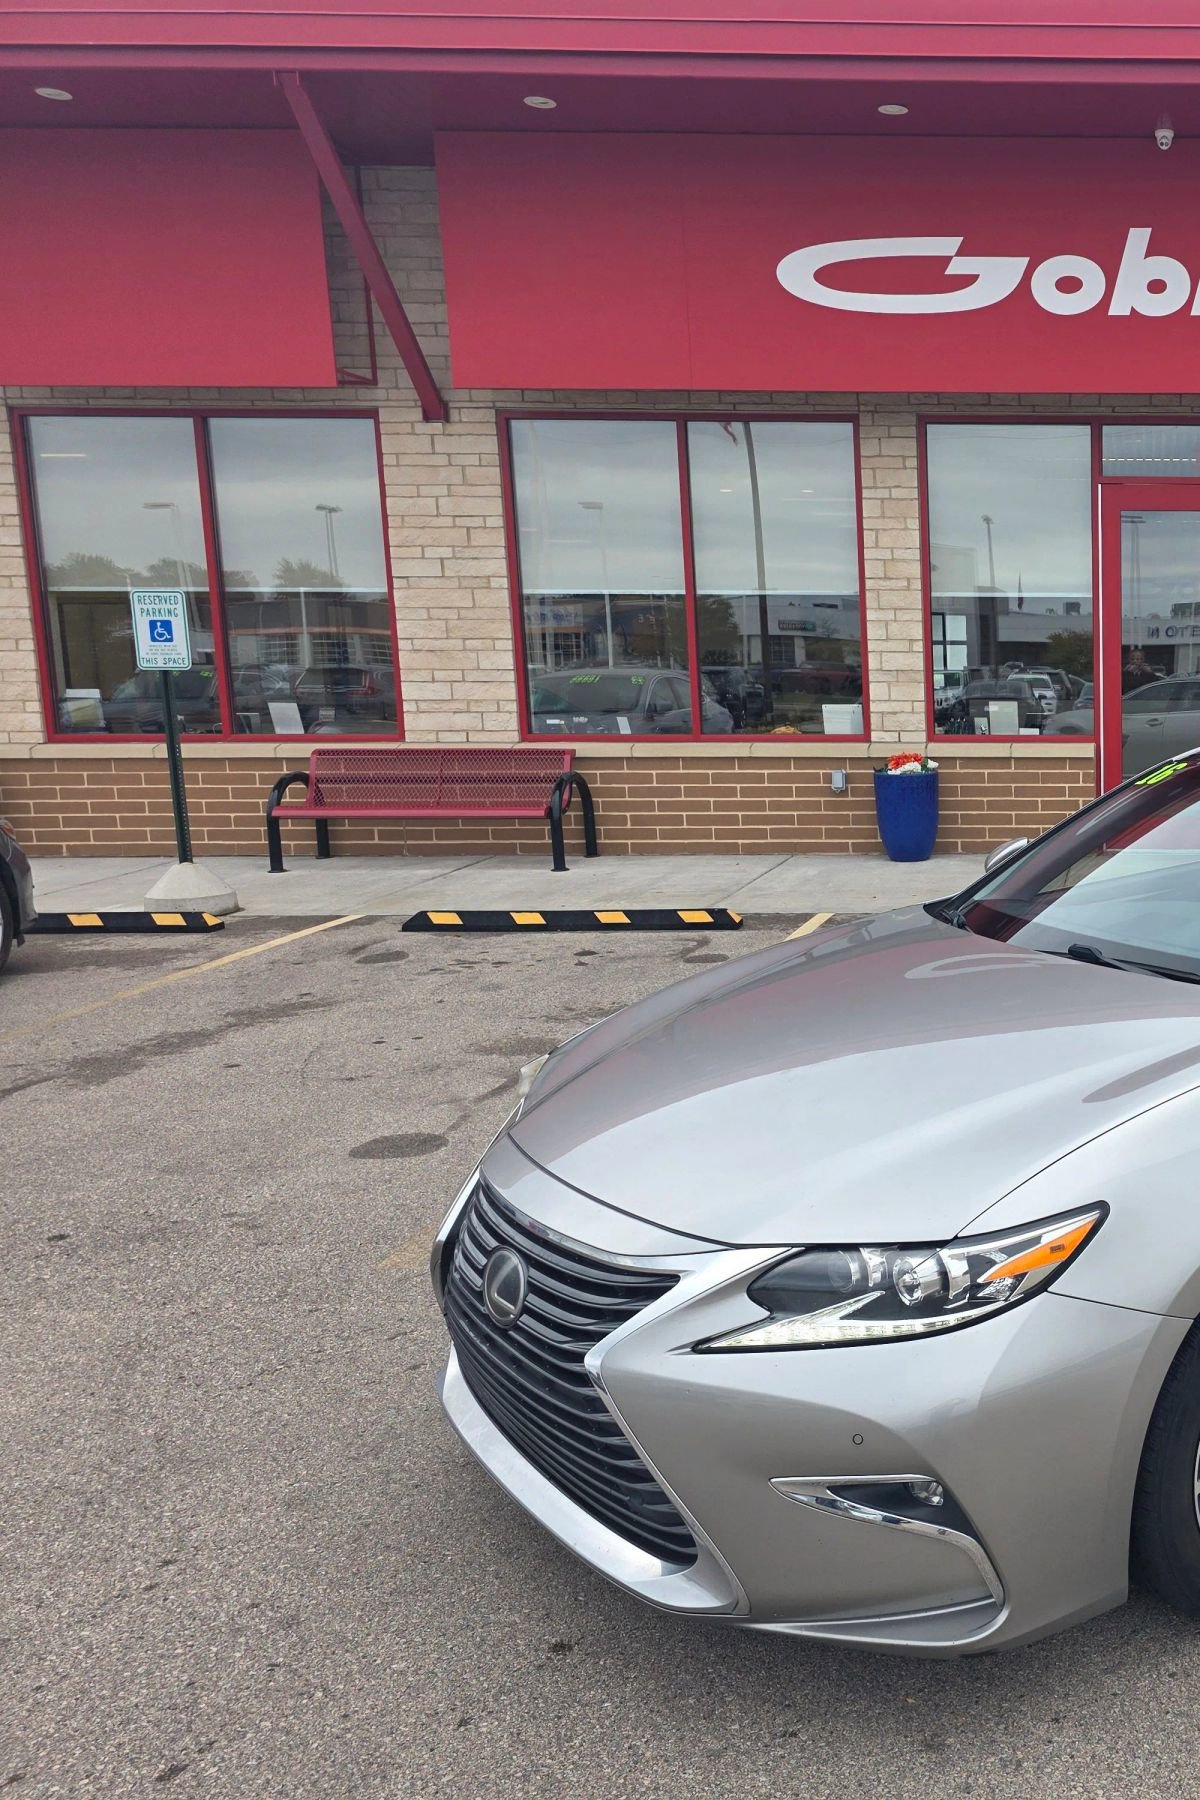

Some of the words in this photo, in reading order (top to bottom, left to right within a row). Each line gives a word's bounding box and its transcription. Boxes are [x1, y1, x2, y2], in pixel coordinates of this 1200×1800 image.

[137, 595, 179, 606] RESERVED
[140, 607, 179, 618] PARKING
[141, 657, 158, 665] THIS
[163, 657, 186, 665] SPACE
[1135, 762, 1187, 785] 16
